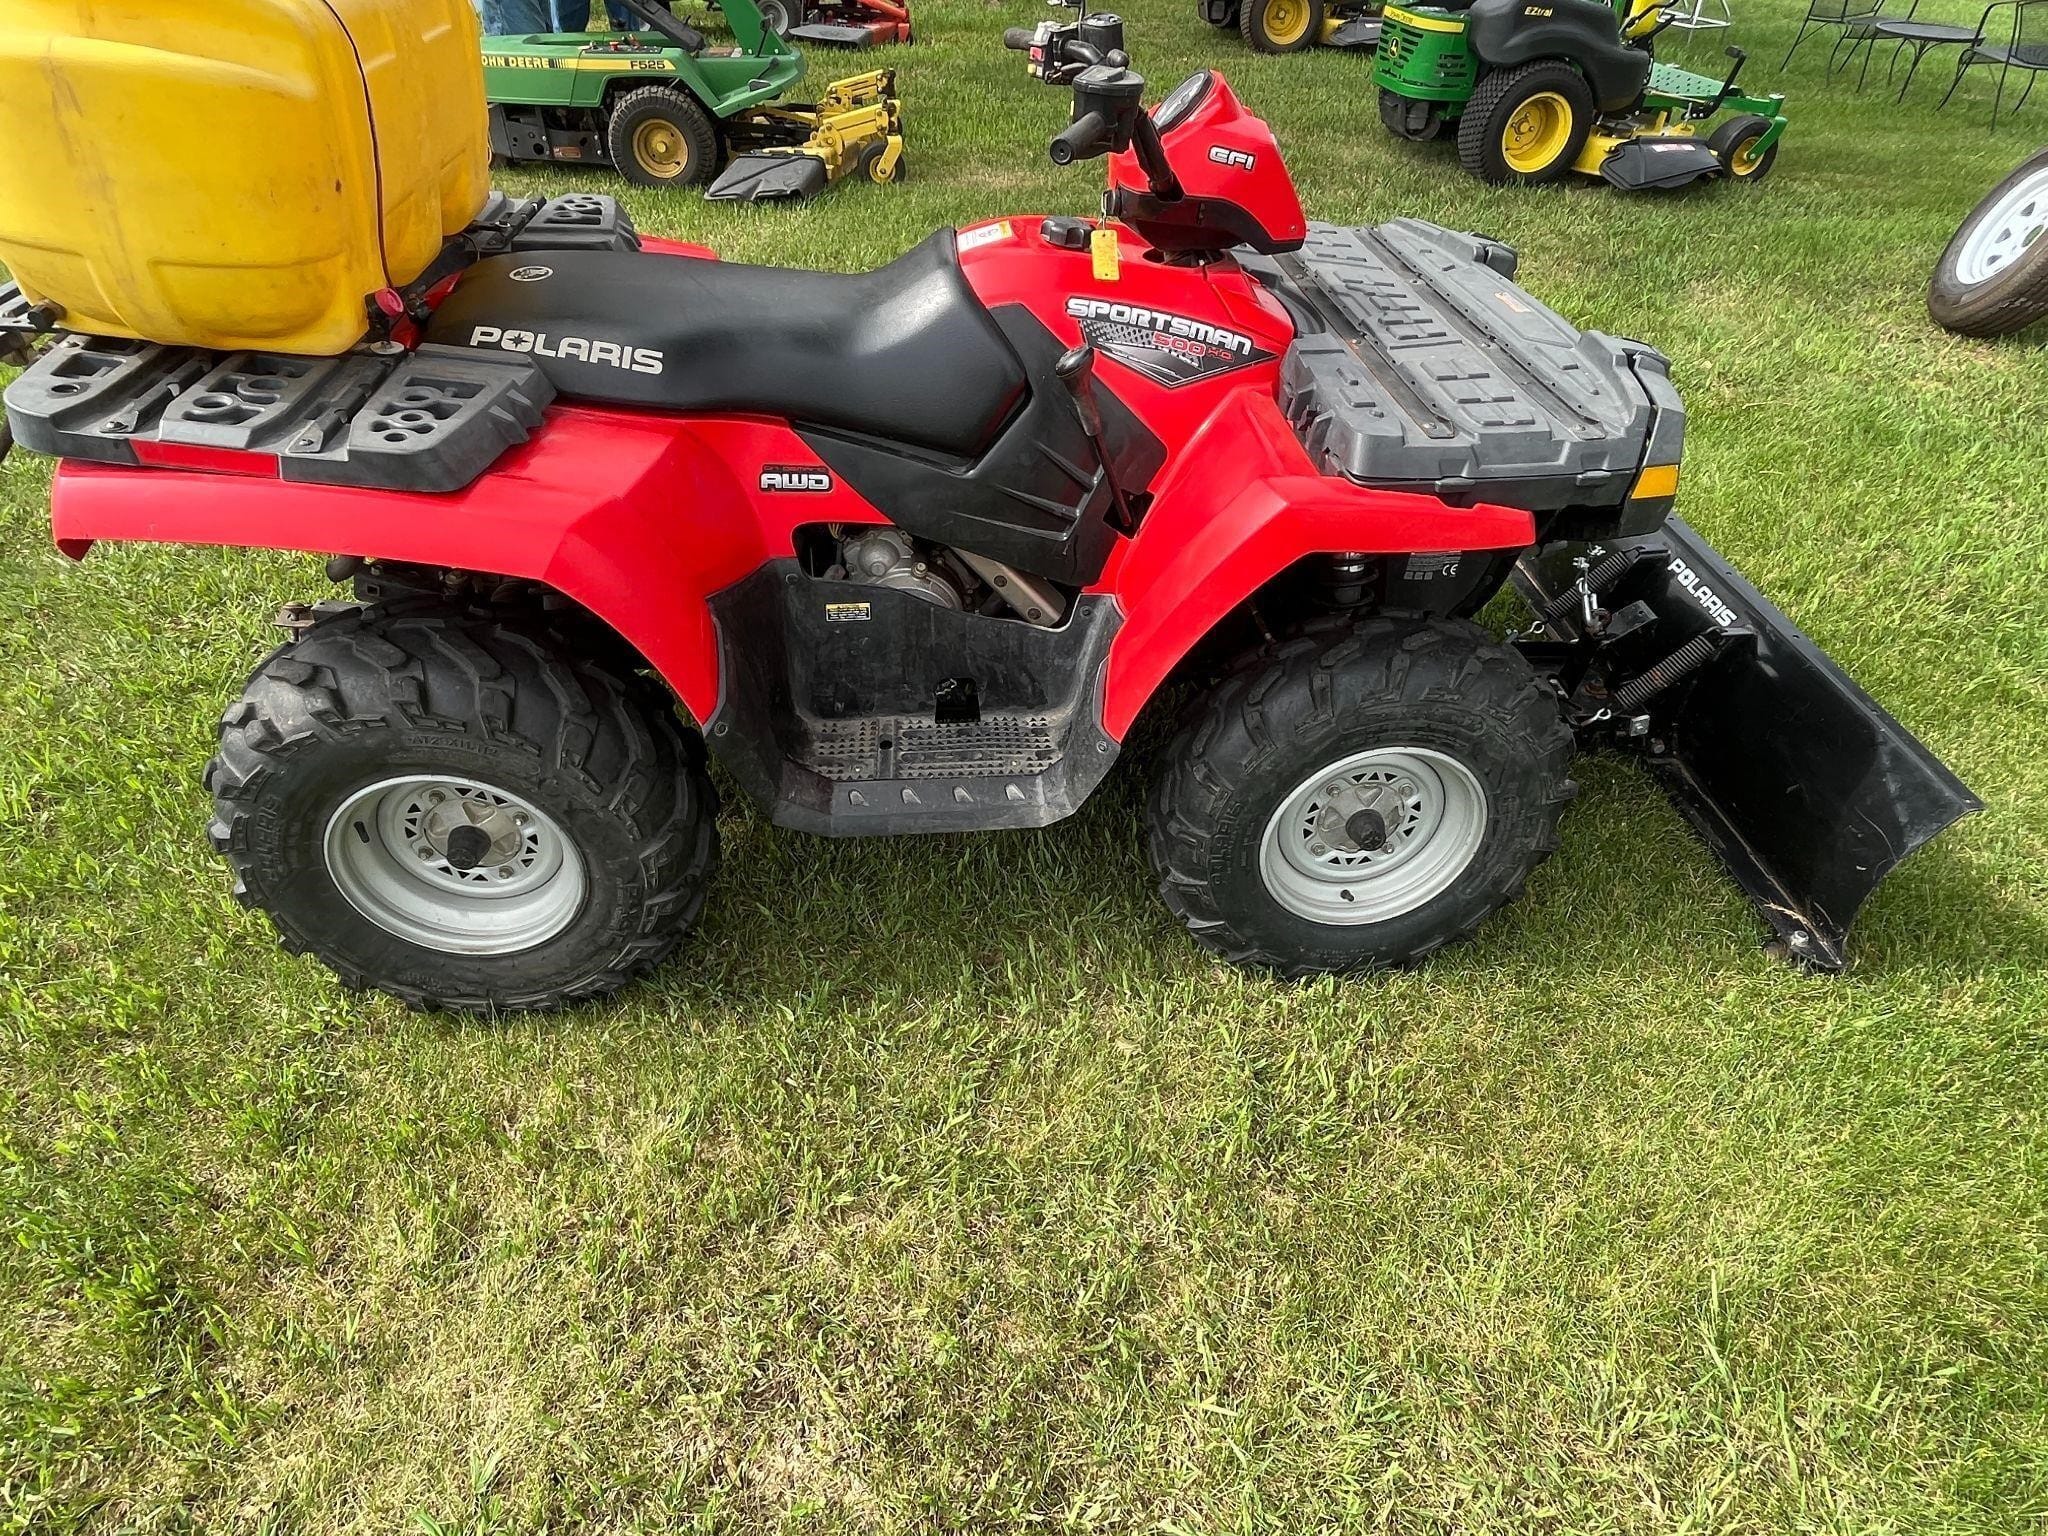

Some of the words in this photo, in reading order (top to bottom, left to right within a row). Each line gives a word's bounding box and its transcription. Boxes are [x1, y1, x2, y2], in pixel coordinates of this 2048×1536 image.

[481, 55, 505, 67] OHN
[509, 56, 550, 68] DEERE
[630, 60, 666, 70] F525
[1210, 146, 1254, 170] EFI
[1066, 298, 1252, 356] SPORTSMAN
[469, 325, 664, 375] POLARIS
[1152, 331, 1206, 357] 500
[760, 473, 830, 490] AWD
[1667, 557, 1738, 627] POLARIS
